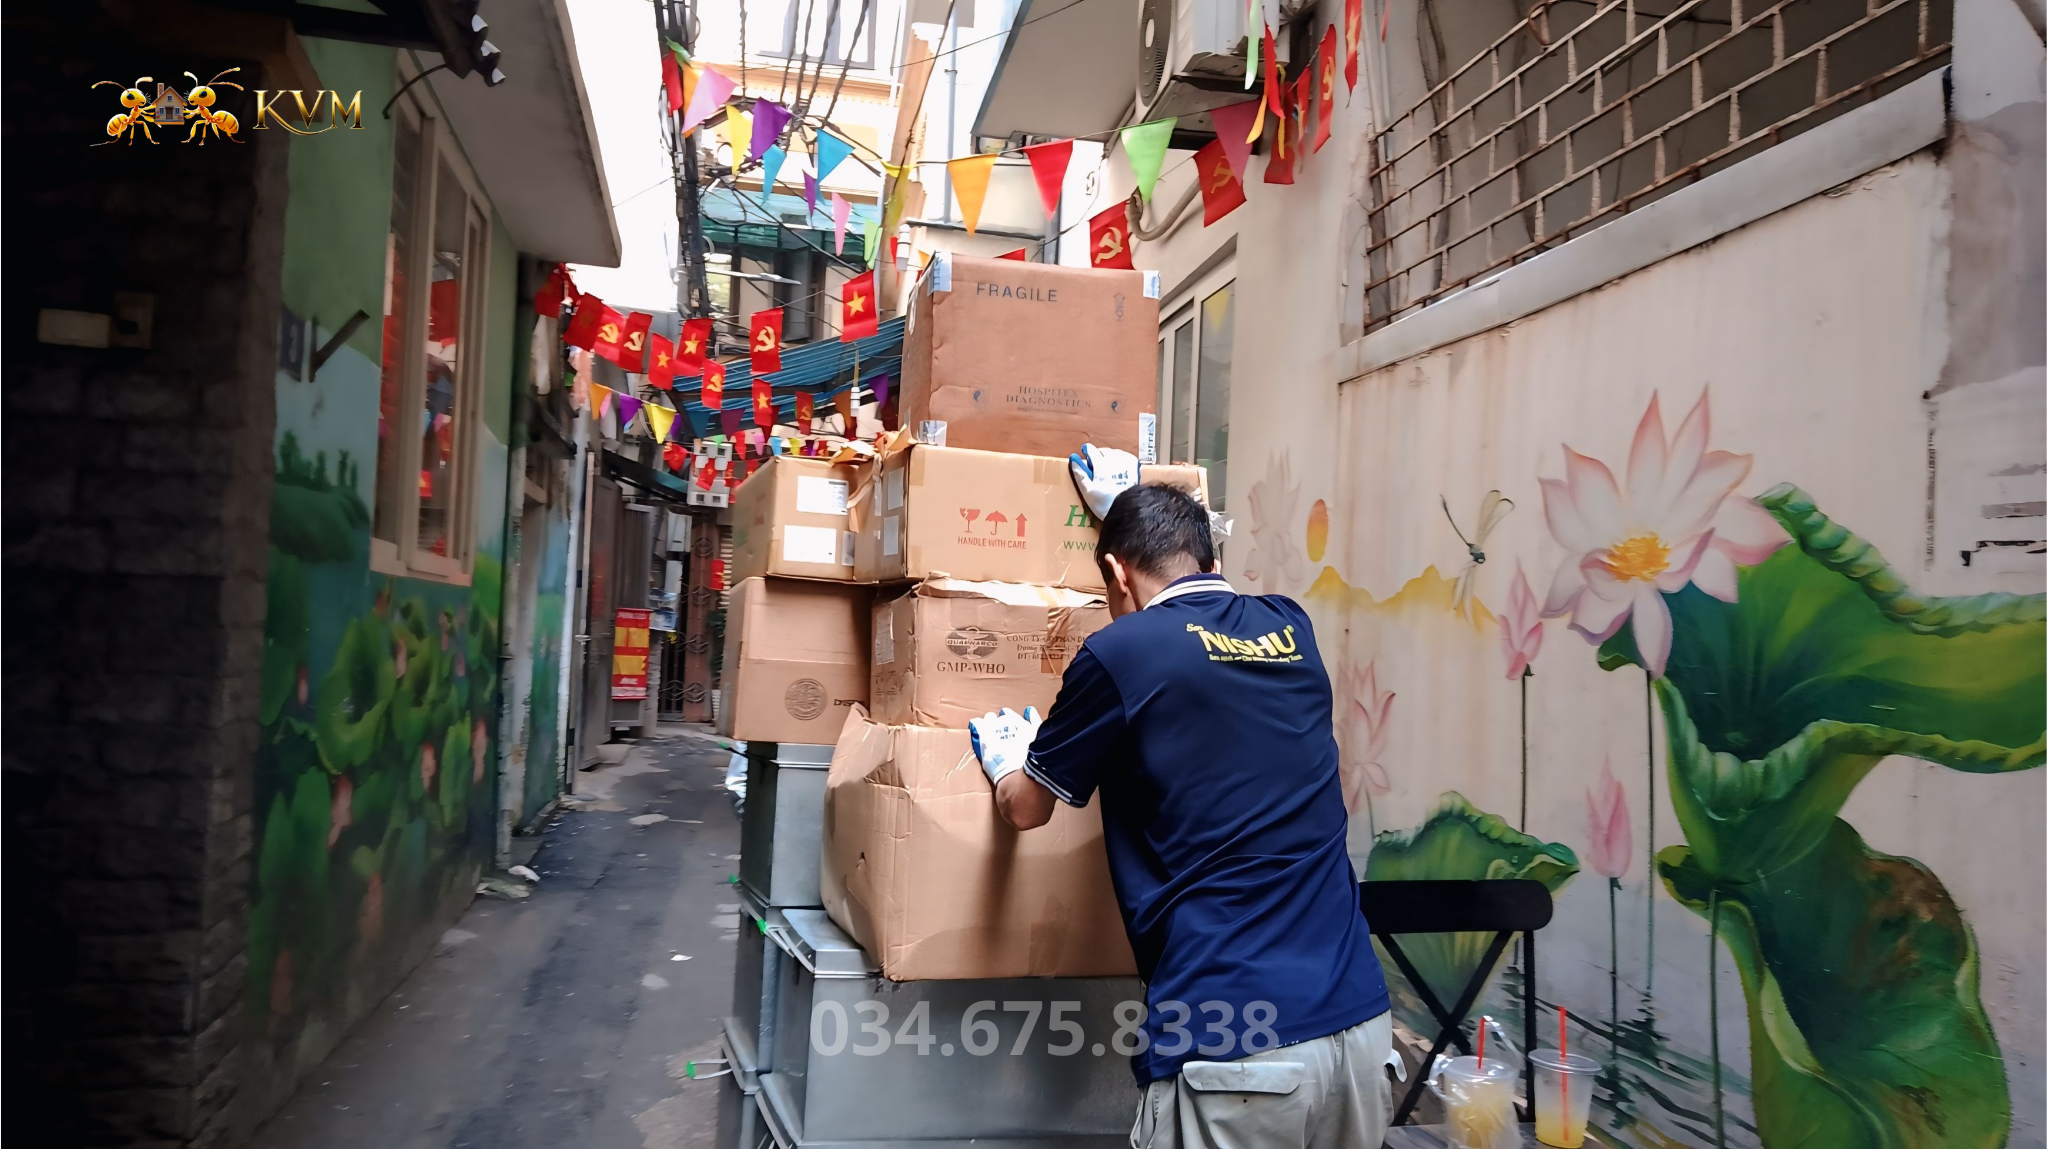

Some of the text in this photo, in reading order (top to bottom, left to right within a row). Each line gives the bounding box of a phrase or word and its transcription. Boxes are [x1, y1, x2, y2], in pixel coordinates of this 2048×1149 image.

[976, 283, 1058, 302] FRAGILE
[1006, 395, 1092, 408] DIAGNOSTICS
[957, 536, 1027, 550] HANDLE WITH CARE
[936, 661, 1006, 674] GMP-WHO
